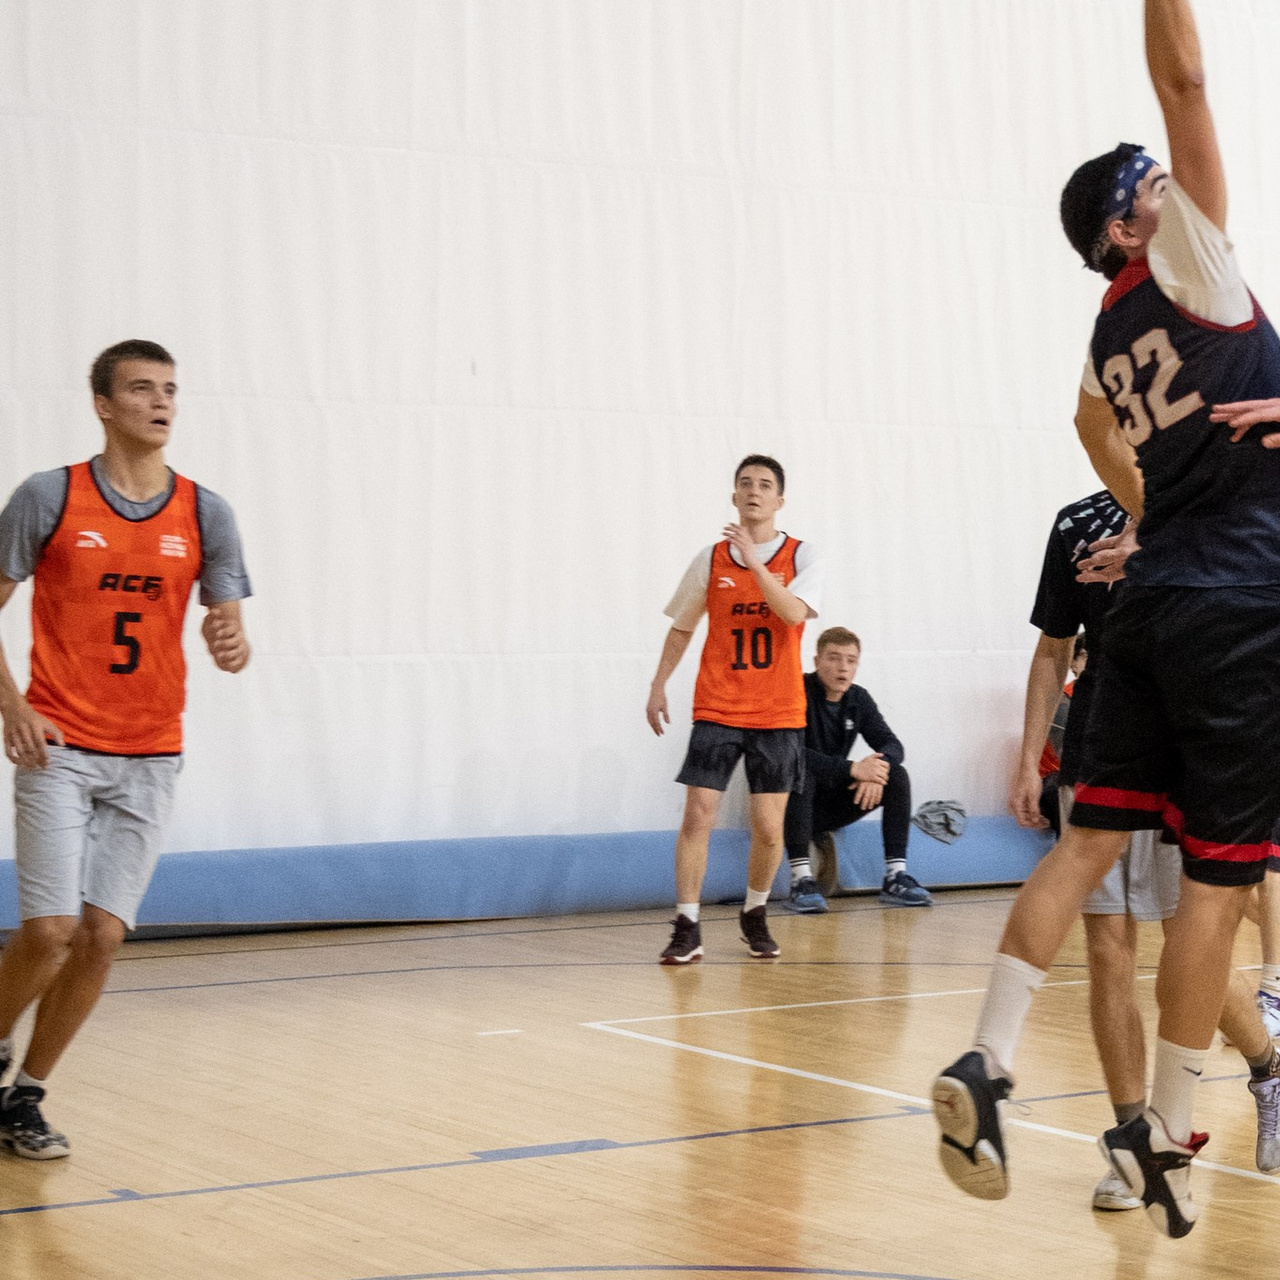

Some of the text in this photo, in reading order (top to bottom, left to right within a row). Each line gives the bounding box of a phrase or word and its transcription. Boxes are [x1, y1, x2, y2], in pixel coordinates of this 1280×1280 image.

[1102, 328, 1205, 447] 32
[109, 611, 142, 675] 5
[731, 627, 773, 670] 10
